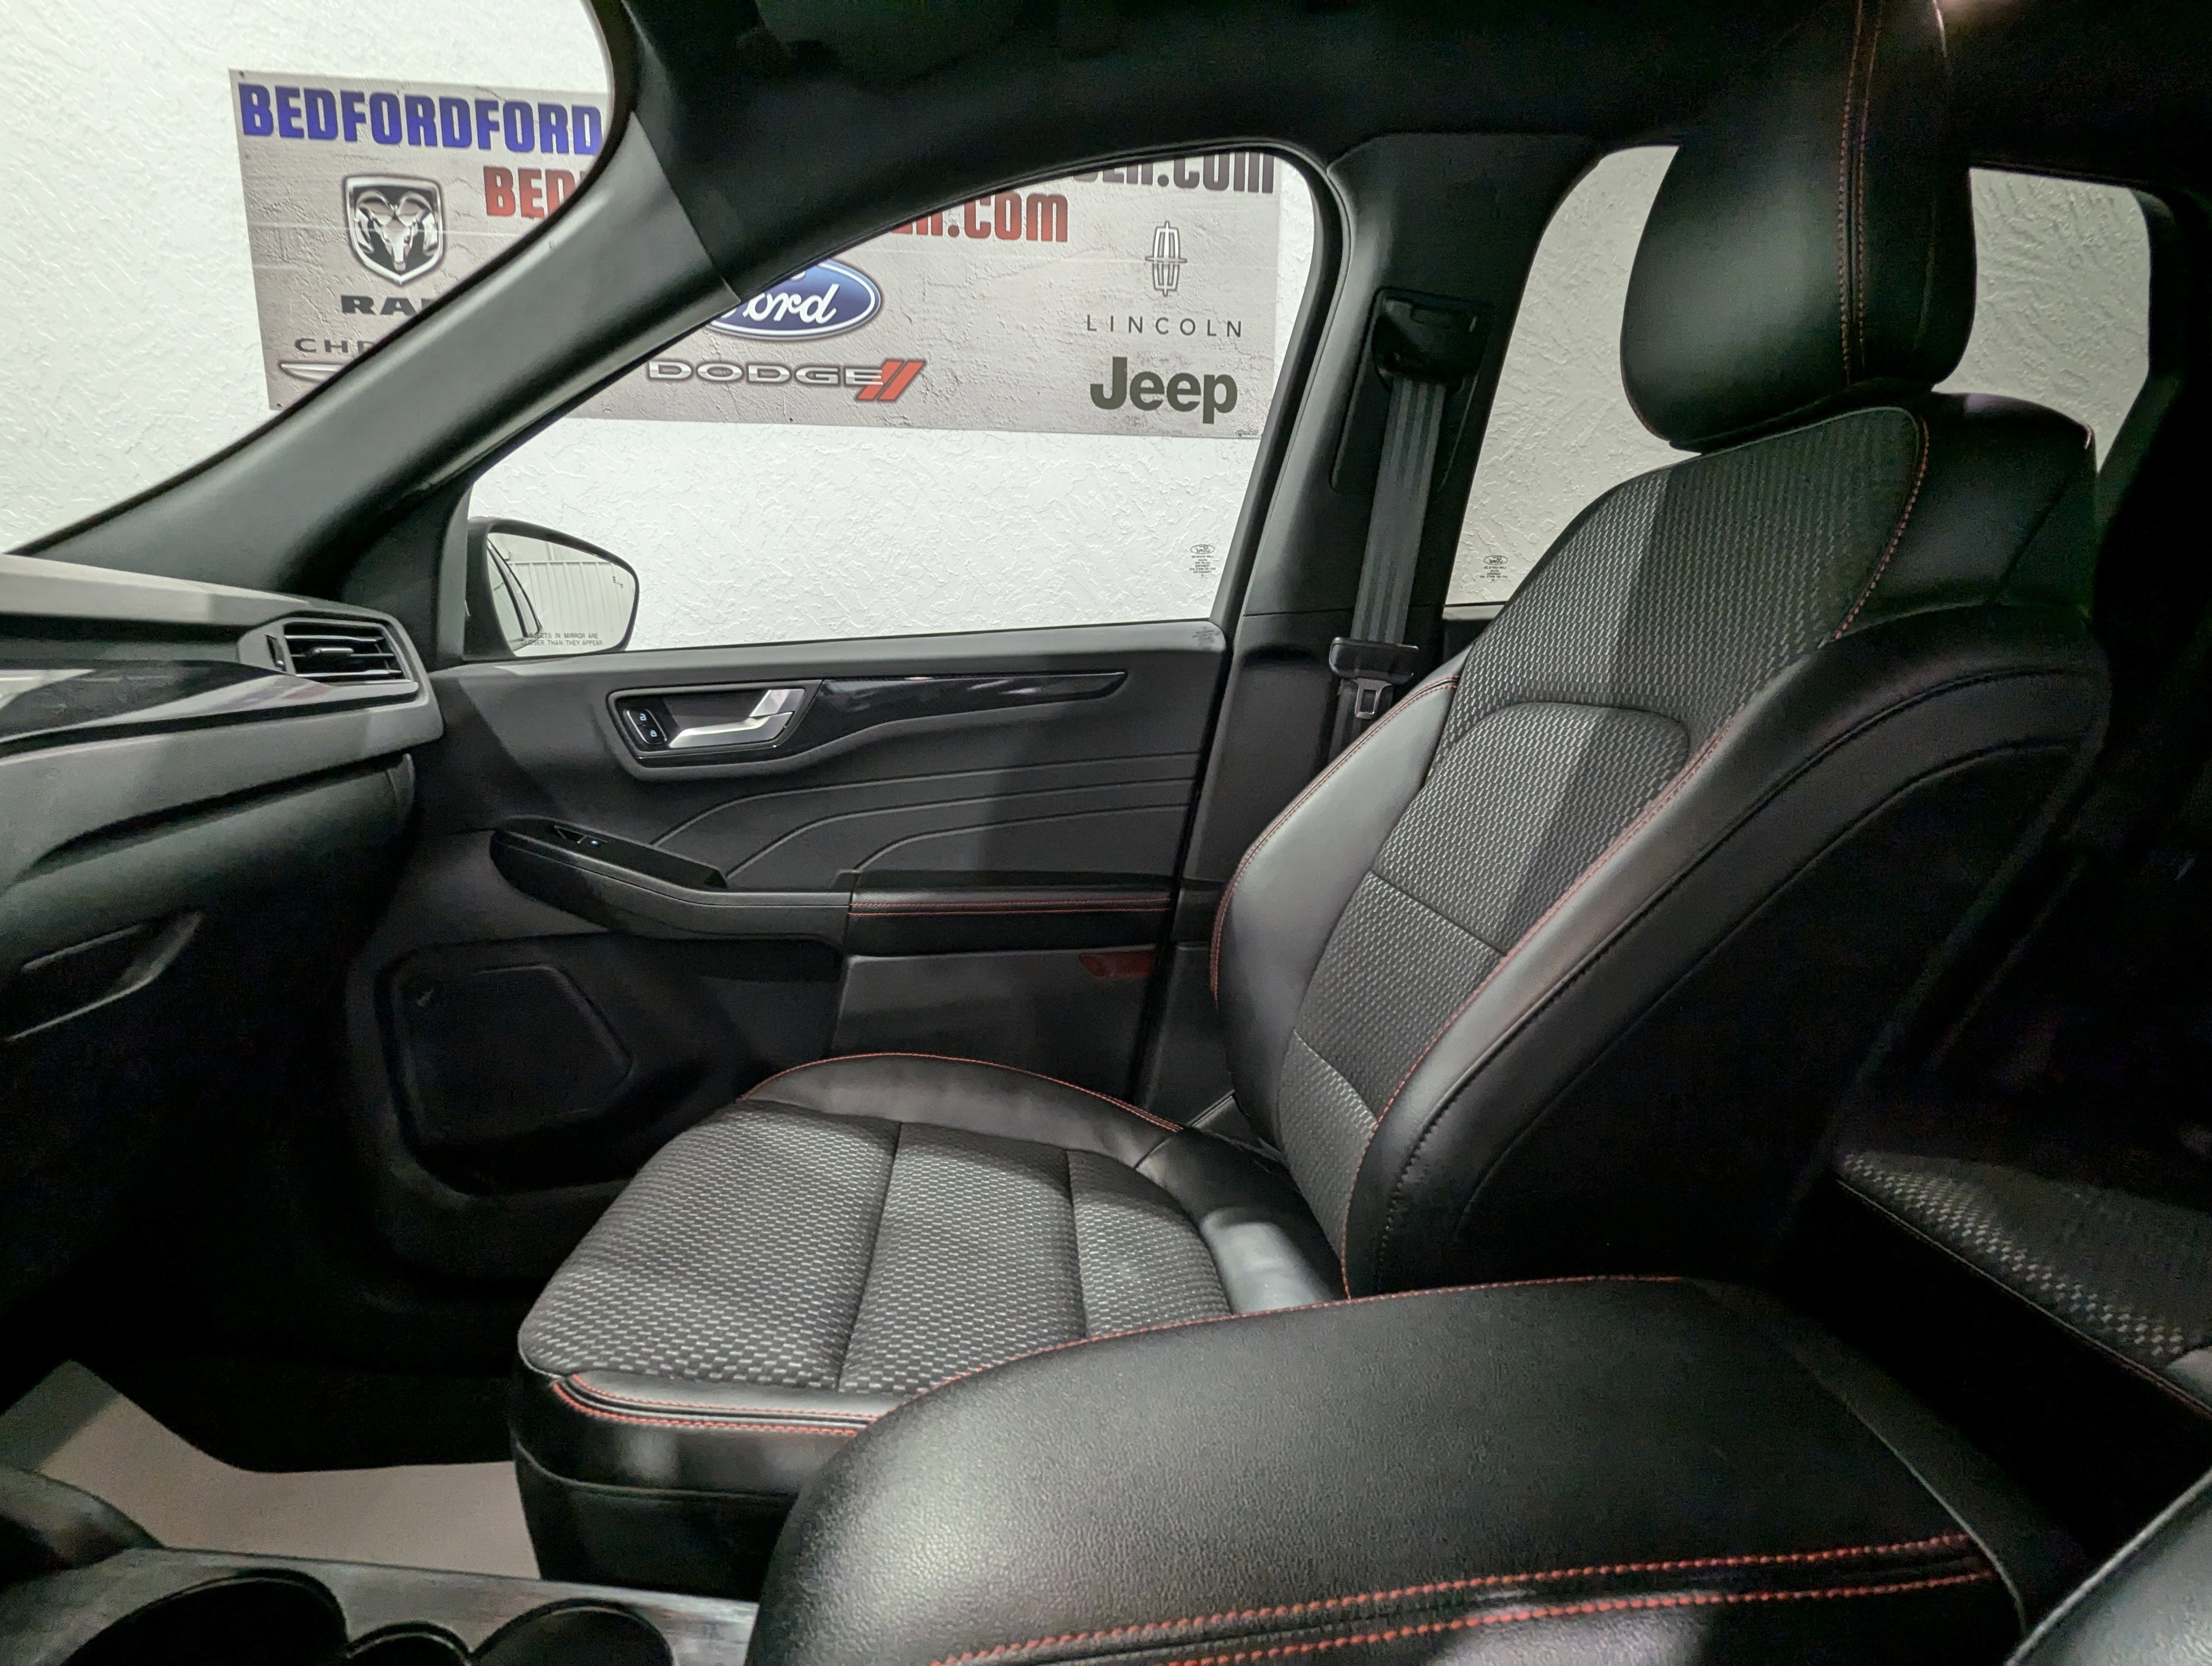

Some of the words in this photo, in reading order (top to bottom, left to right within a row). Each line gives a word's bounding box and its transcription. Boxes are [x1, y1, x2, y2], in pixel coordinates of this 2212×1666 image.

[239, 84, 603, 155] BEDFORDFORD
[483, 166, 588, 219] BED
[721, 271, 840, 324] ord
[1086, 314, 1242, 337] LINCOLN
[648, 360, 884, 387] DODGE
[1090, 356, 1238, 424] Jeep
